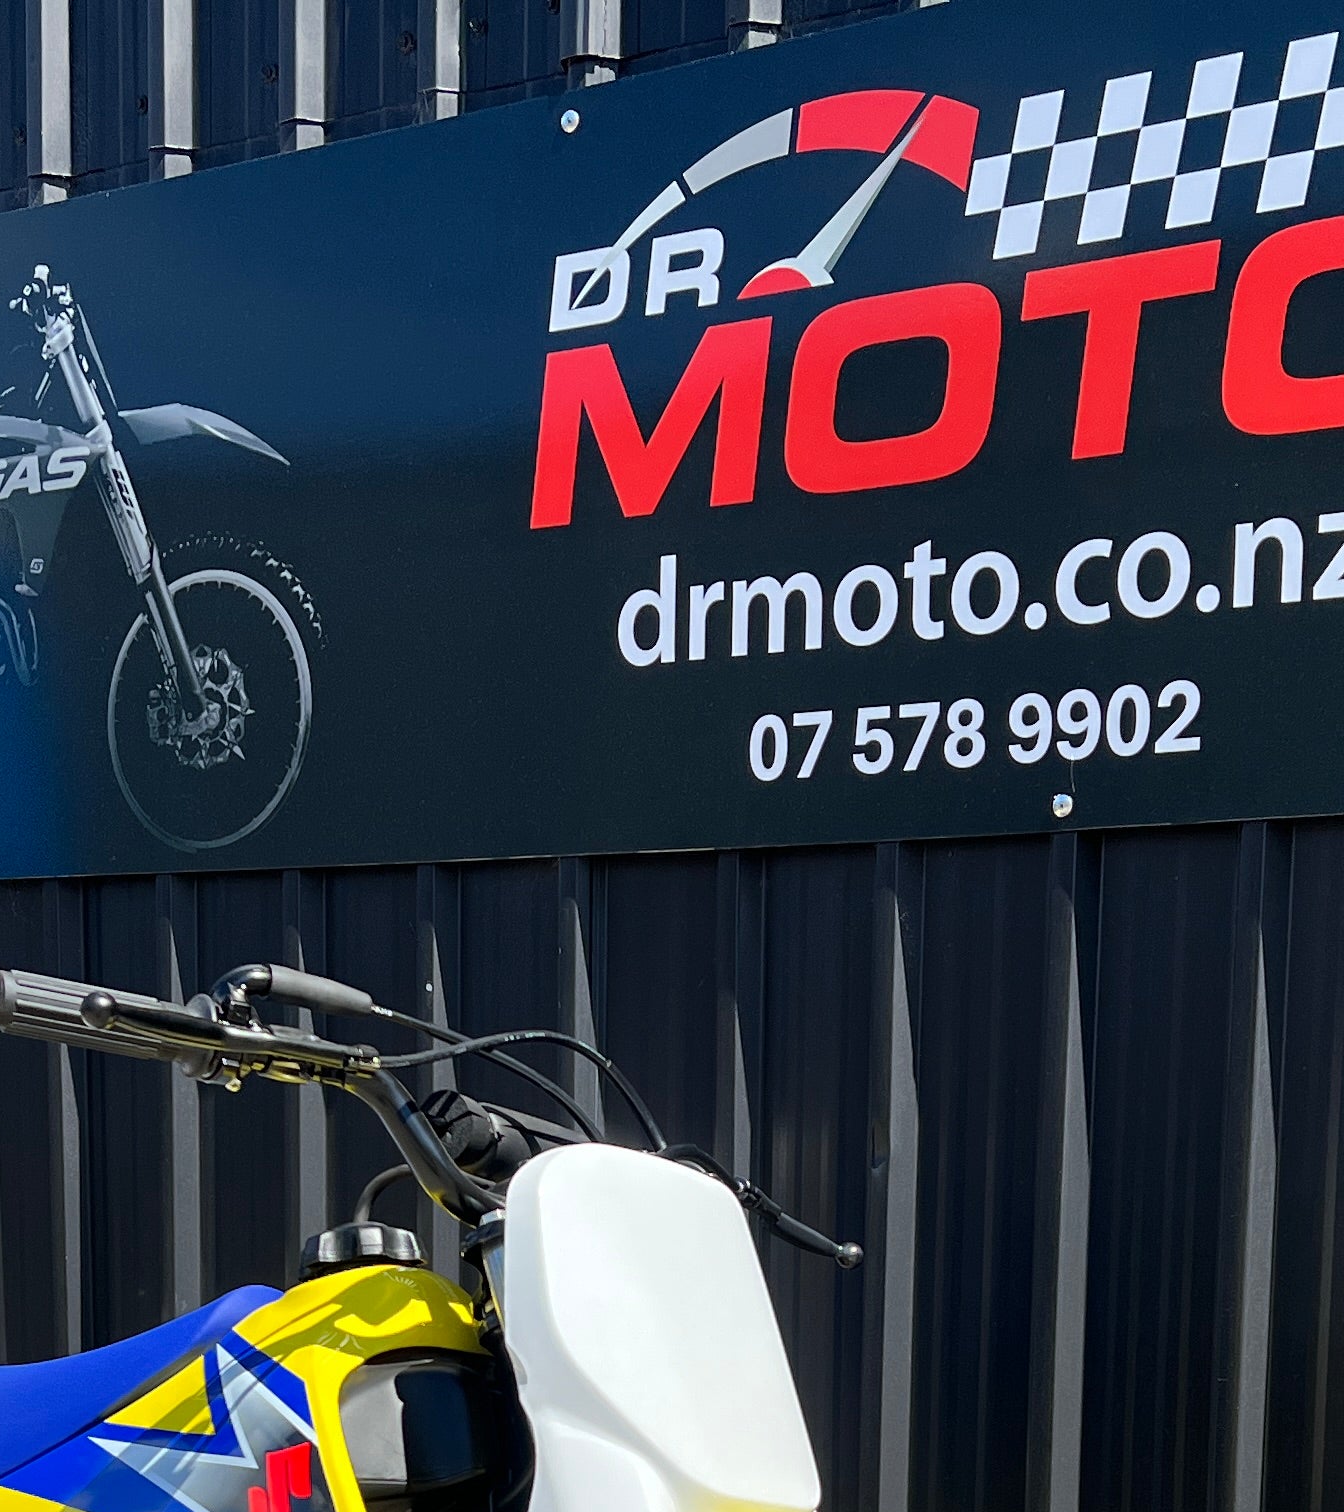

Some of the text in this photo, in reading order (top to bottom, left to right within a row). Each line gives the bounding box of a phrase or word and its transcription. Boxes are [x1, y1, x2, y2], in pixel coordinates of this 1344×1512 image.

[549, 228, 724, 333] DR
[749, 679, 1201, 782] 07 578 9902
